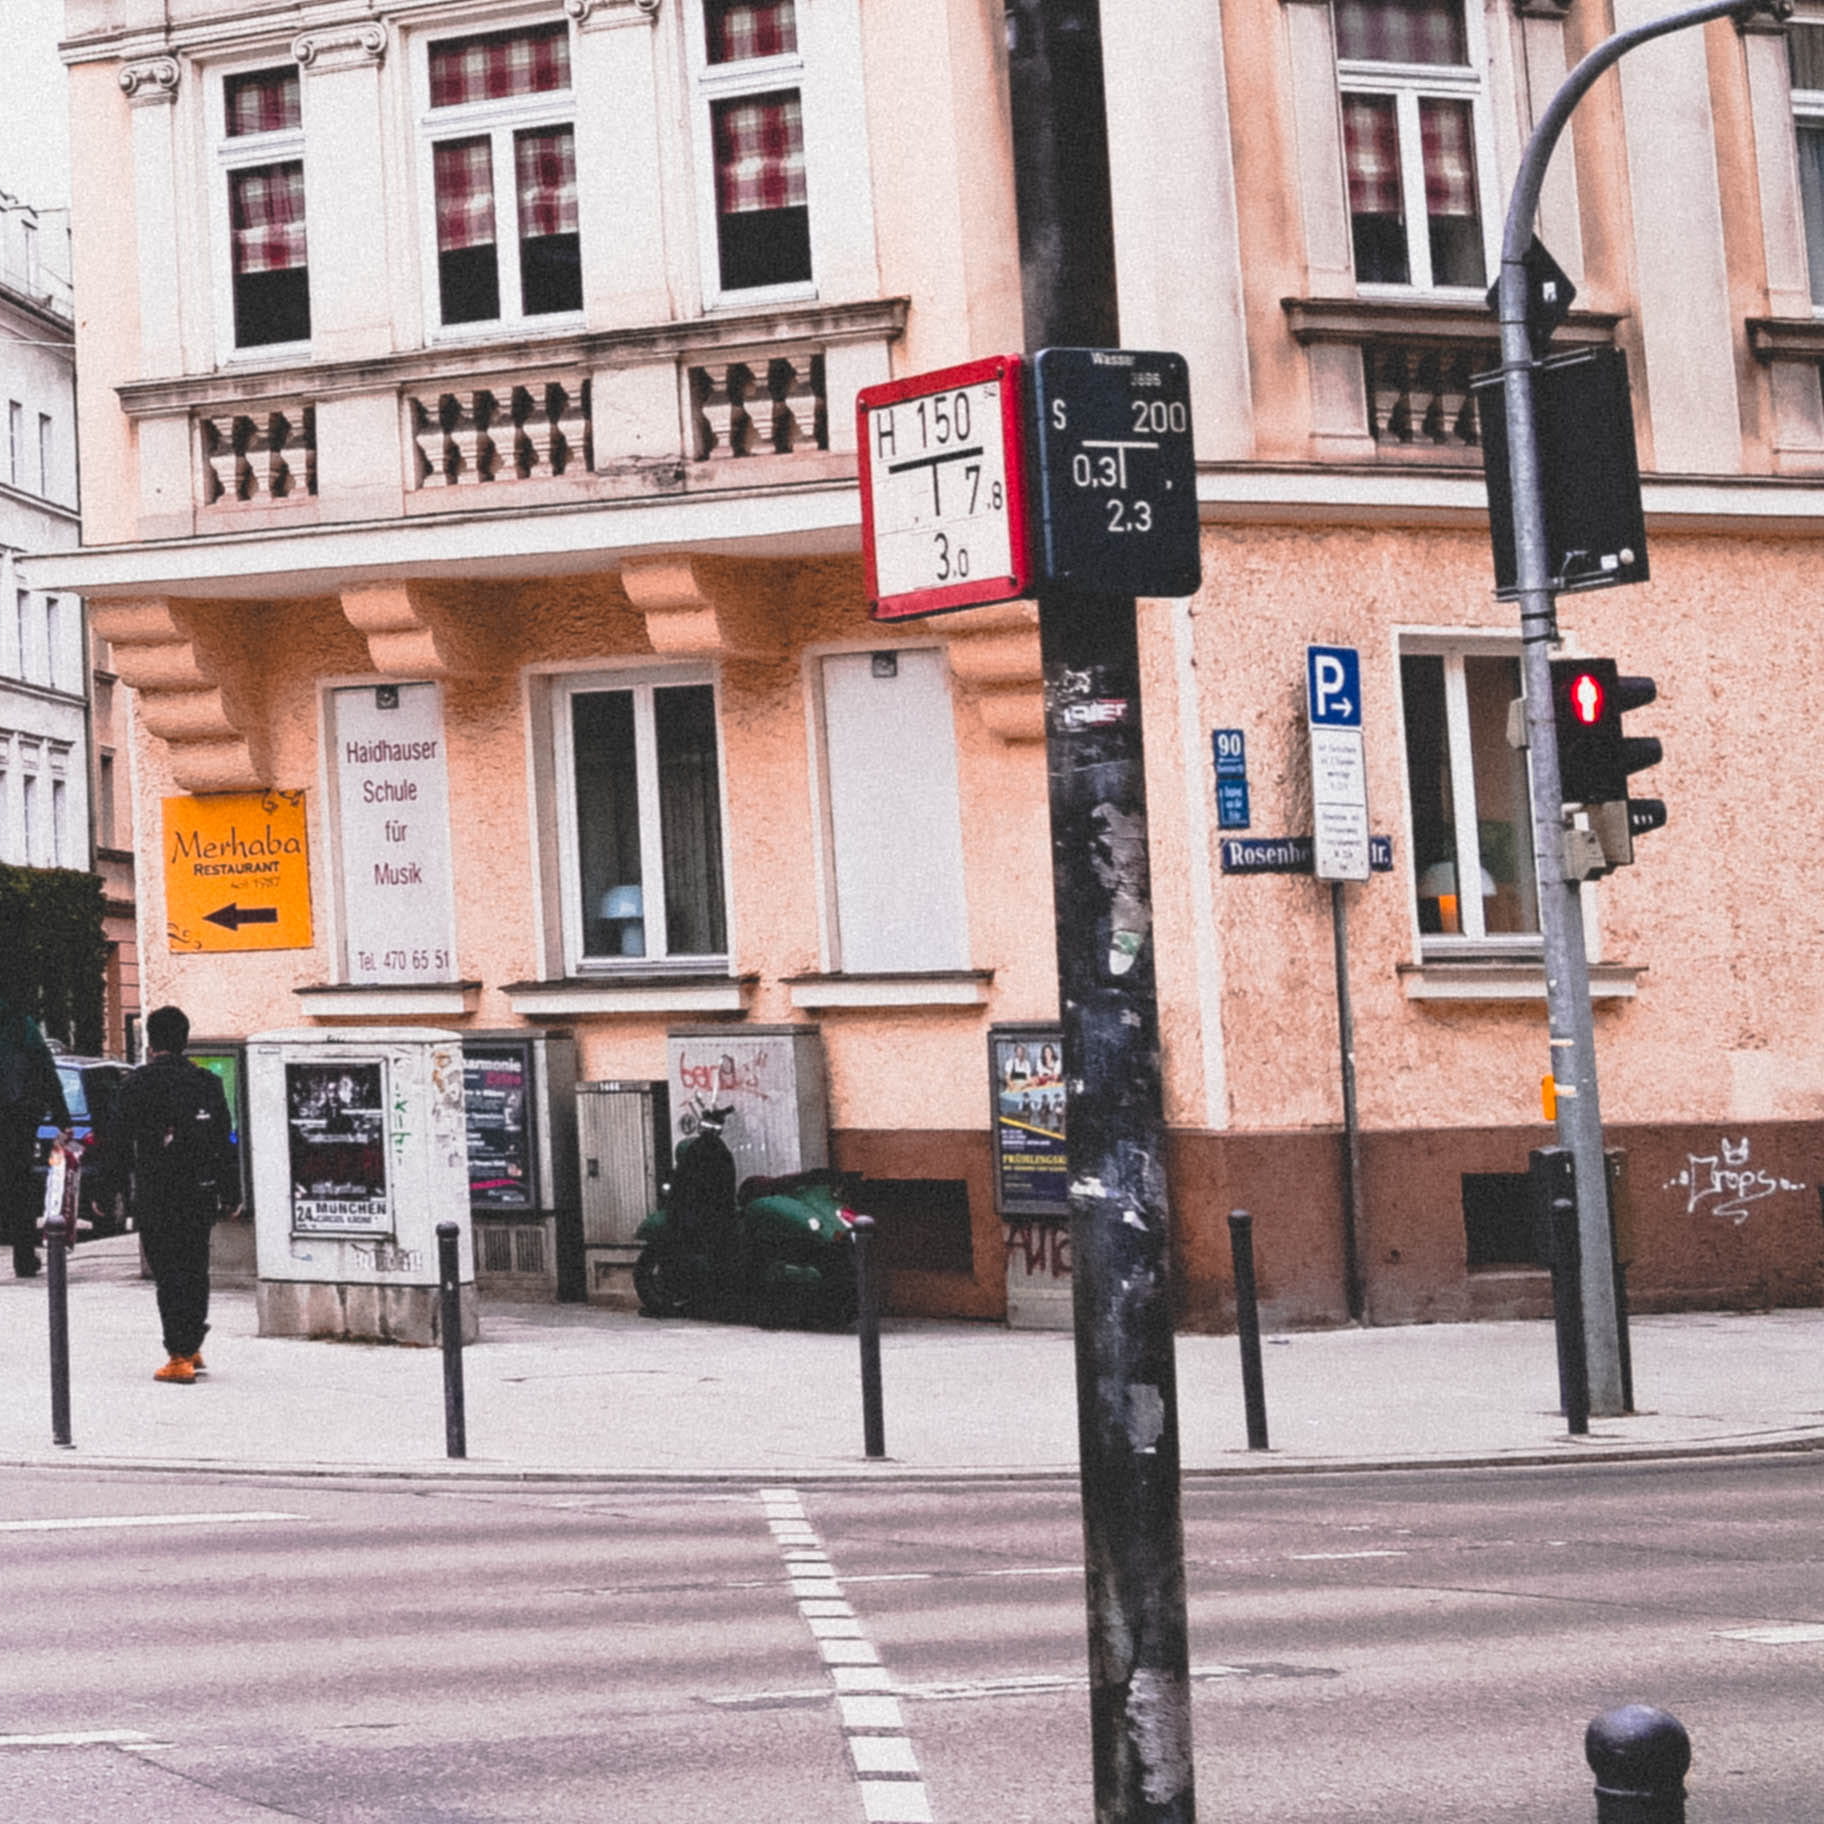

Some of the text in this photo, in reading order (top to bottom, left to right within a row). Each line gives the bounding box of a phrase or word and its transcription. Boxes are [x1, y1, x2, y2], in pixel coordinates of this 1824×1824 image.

[876, 391, 971, 459] H 150
[1052, 399, 1187, 434] S 200
[346, 740, 438, 763] Haidhauser
[1218, 733, 1241, 757] 90
[363, 779, 418, 804] Schule
[385, 820, 408, 843] für
[171, 824, 301, 864] Merhaba
[374, 862, 423, 886] Musik
[358, 949, 449, 972] Tel. 470 65 51
[316, 1201, 387, 1215] MÜNCHEN
